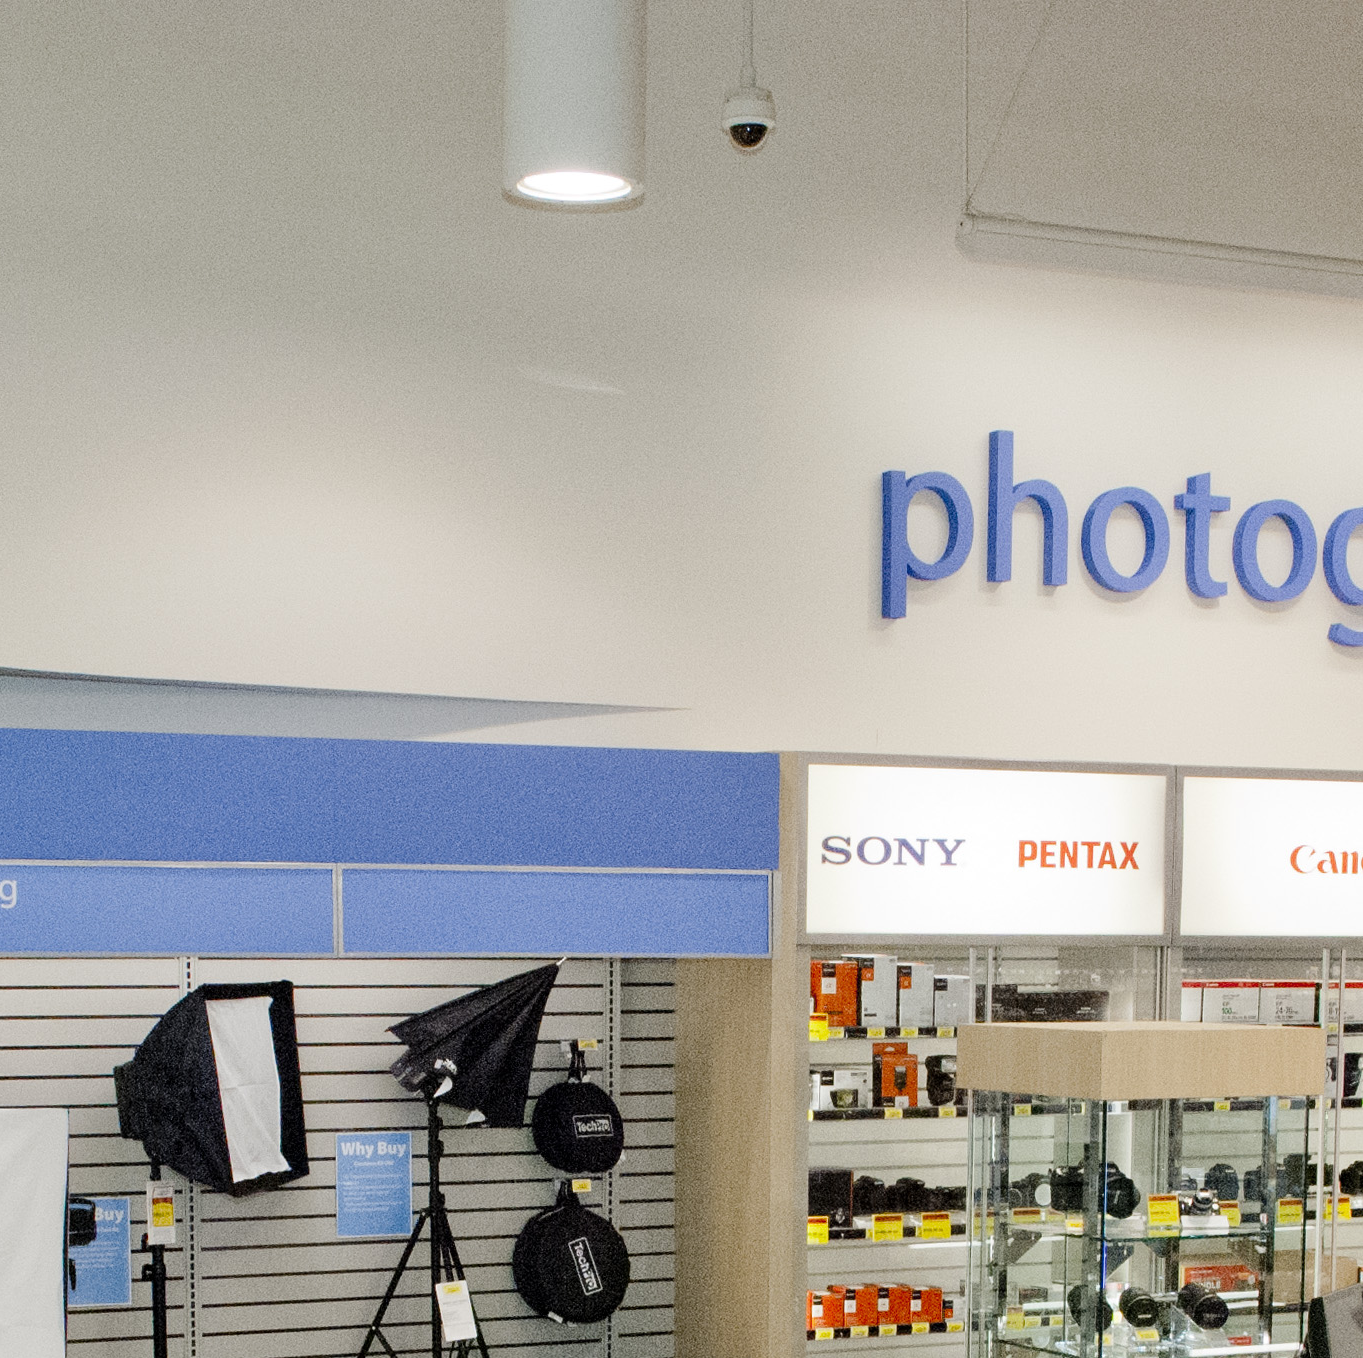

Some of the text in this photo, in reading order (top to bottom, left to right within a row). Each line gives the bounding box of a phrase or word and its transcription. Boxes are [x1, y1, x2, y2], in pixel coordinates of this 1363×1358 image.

[821, 835, 965, 868] SONY
[1018, 840, 1139, 871] PENTAX
[341, 1141, 407, 1159] Why Buy
